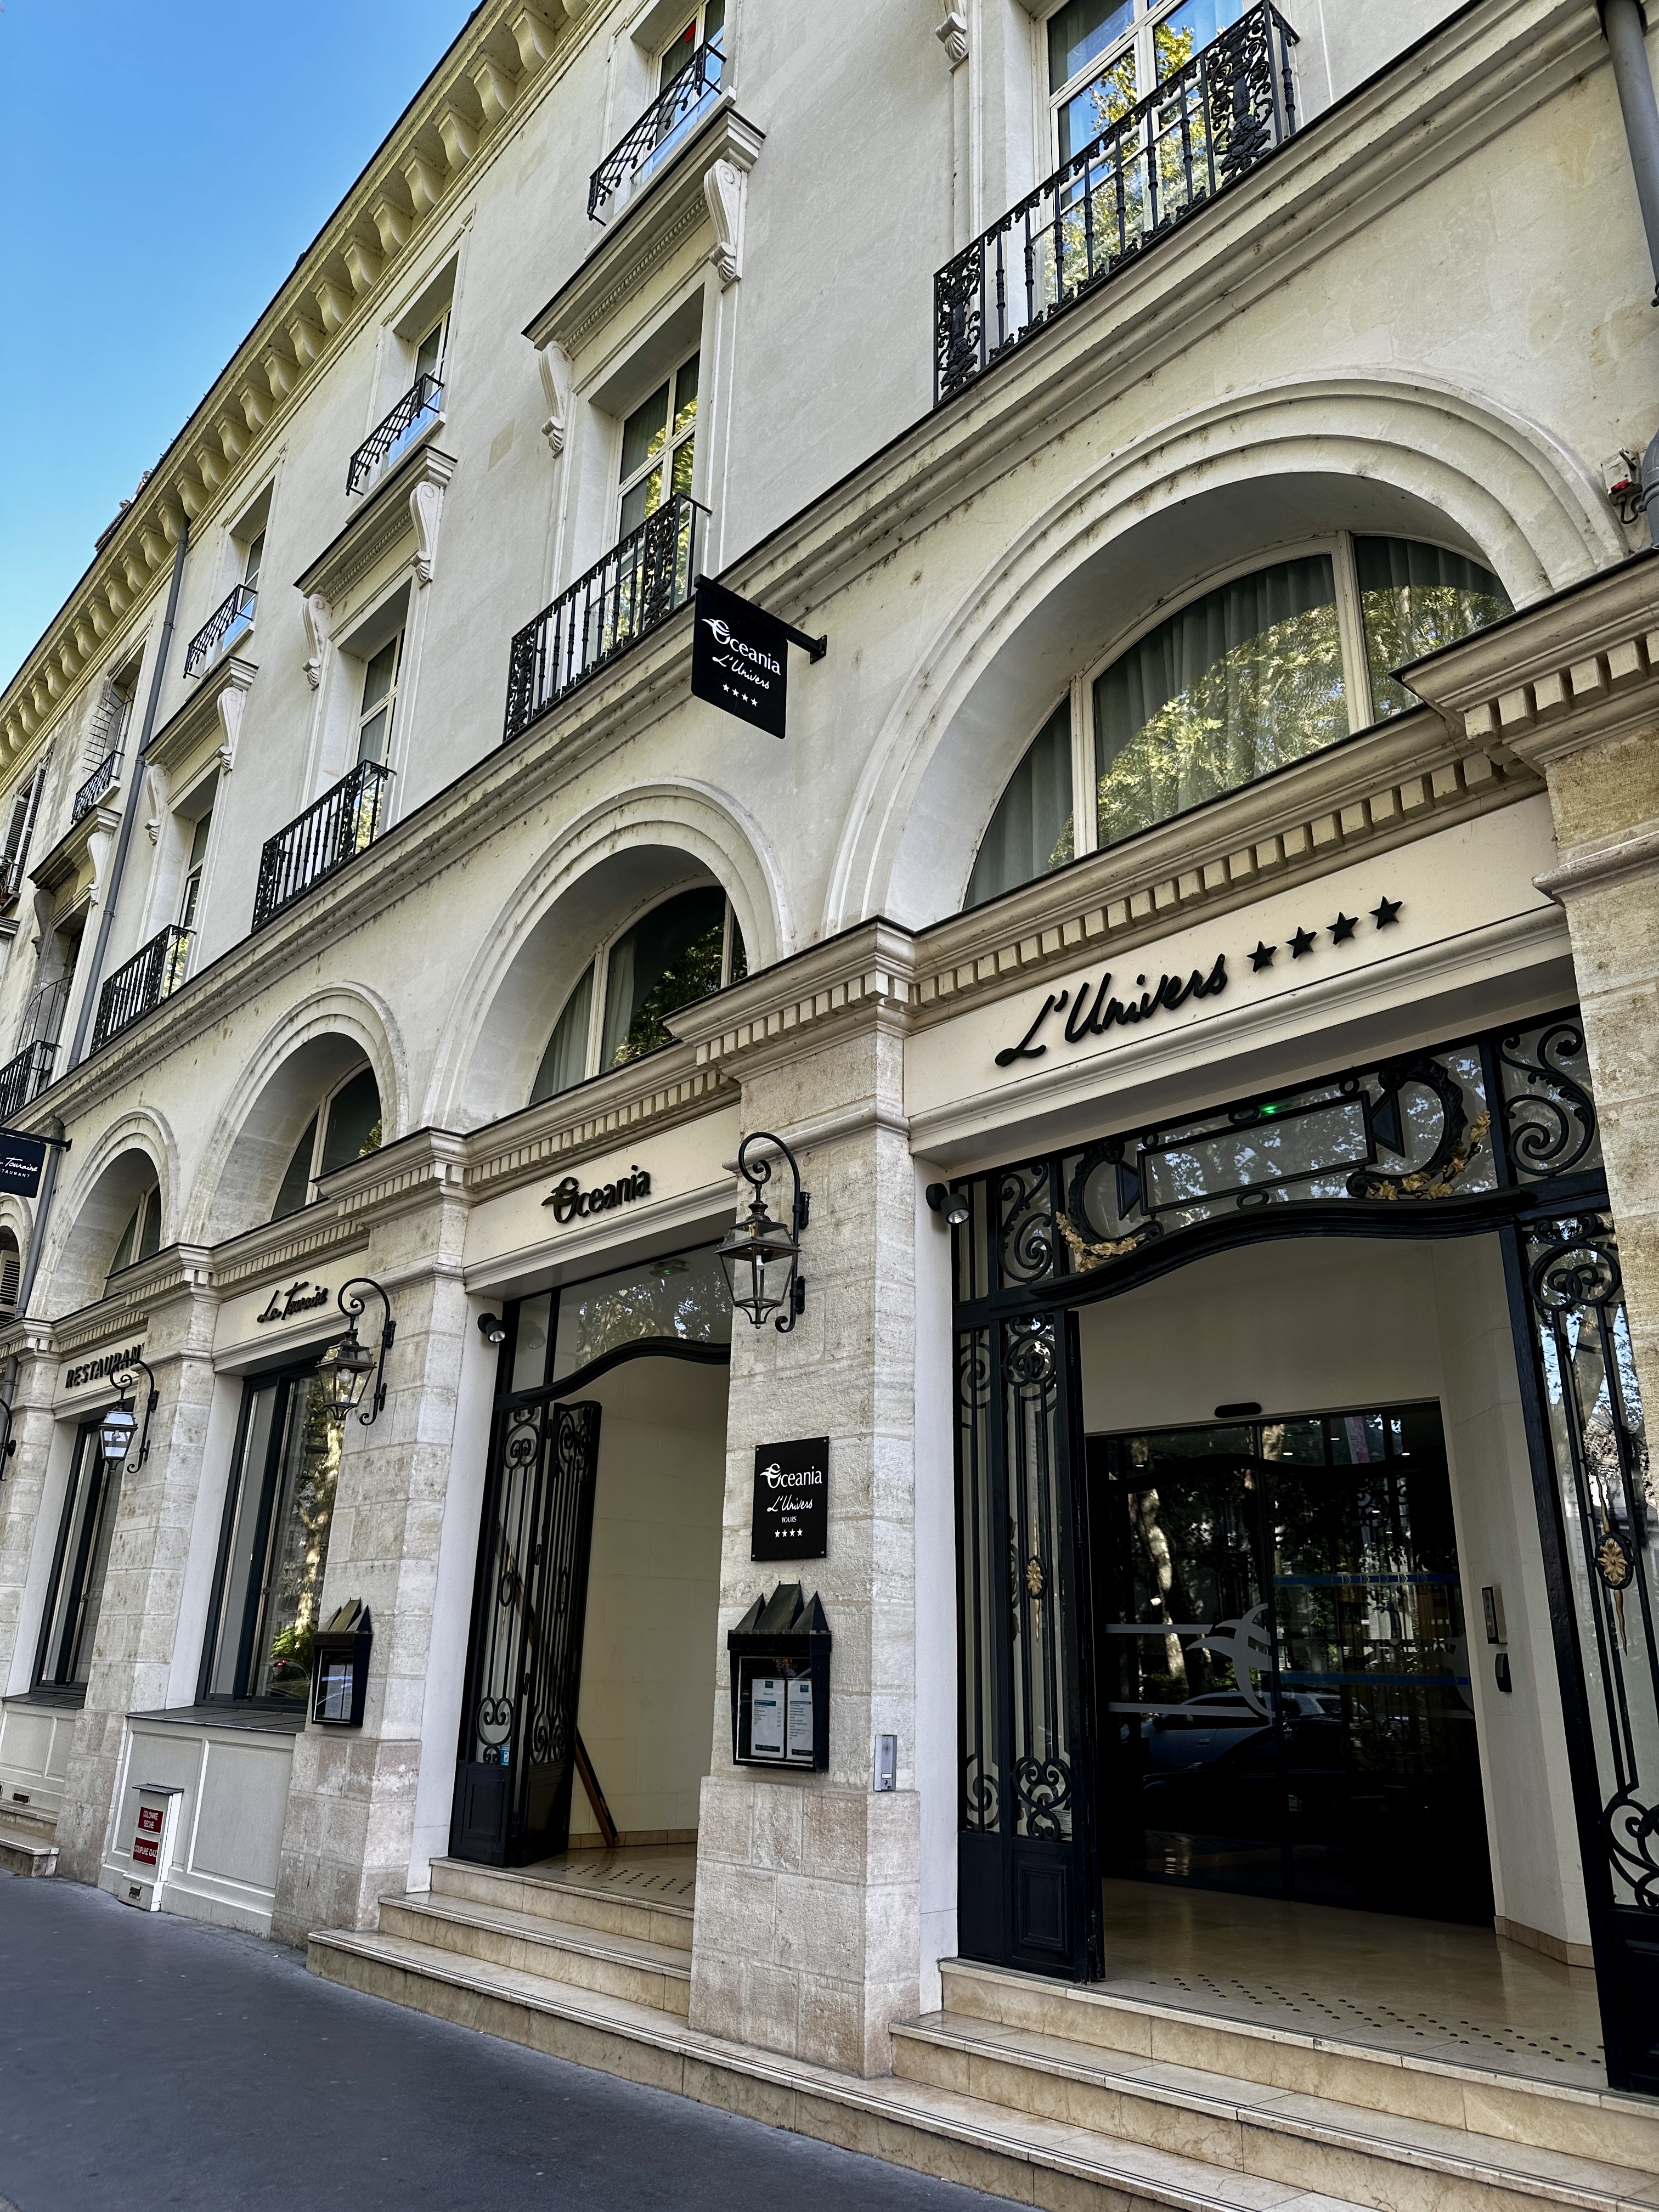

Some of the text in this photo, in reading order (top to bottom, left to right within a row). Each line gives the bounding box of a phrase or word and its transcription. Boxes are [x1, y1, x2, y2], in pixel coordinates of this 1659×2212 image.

[702, 618, 781, 675] Oceania
[712, 654, 769, 689] L'Univers
[995, 953, 1228, 1066] L'Univers
[0, 1169, 30, 1178] TAURANT
[5, 1156, 38, 1172] Touraine
[541, 1165, 651, 1224] Oceania
[760, 1463, 822, 1488] Oceania
[767, 1494, 813, 1512] L'Univers
